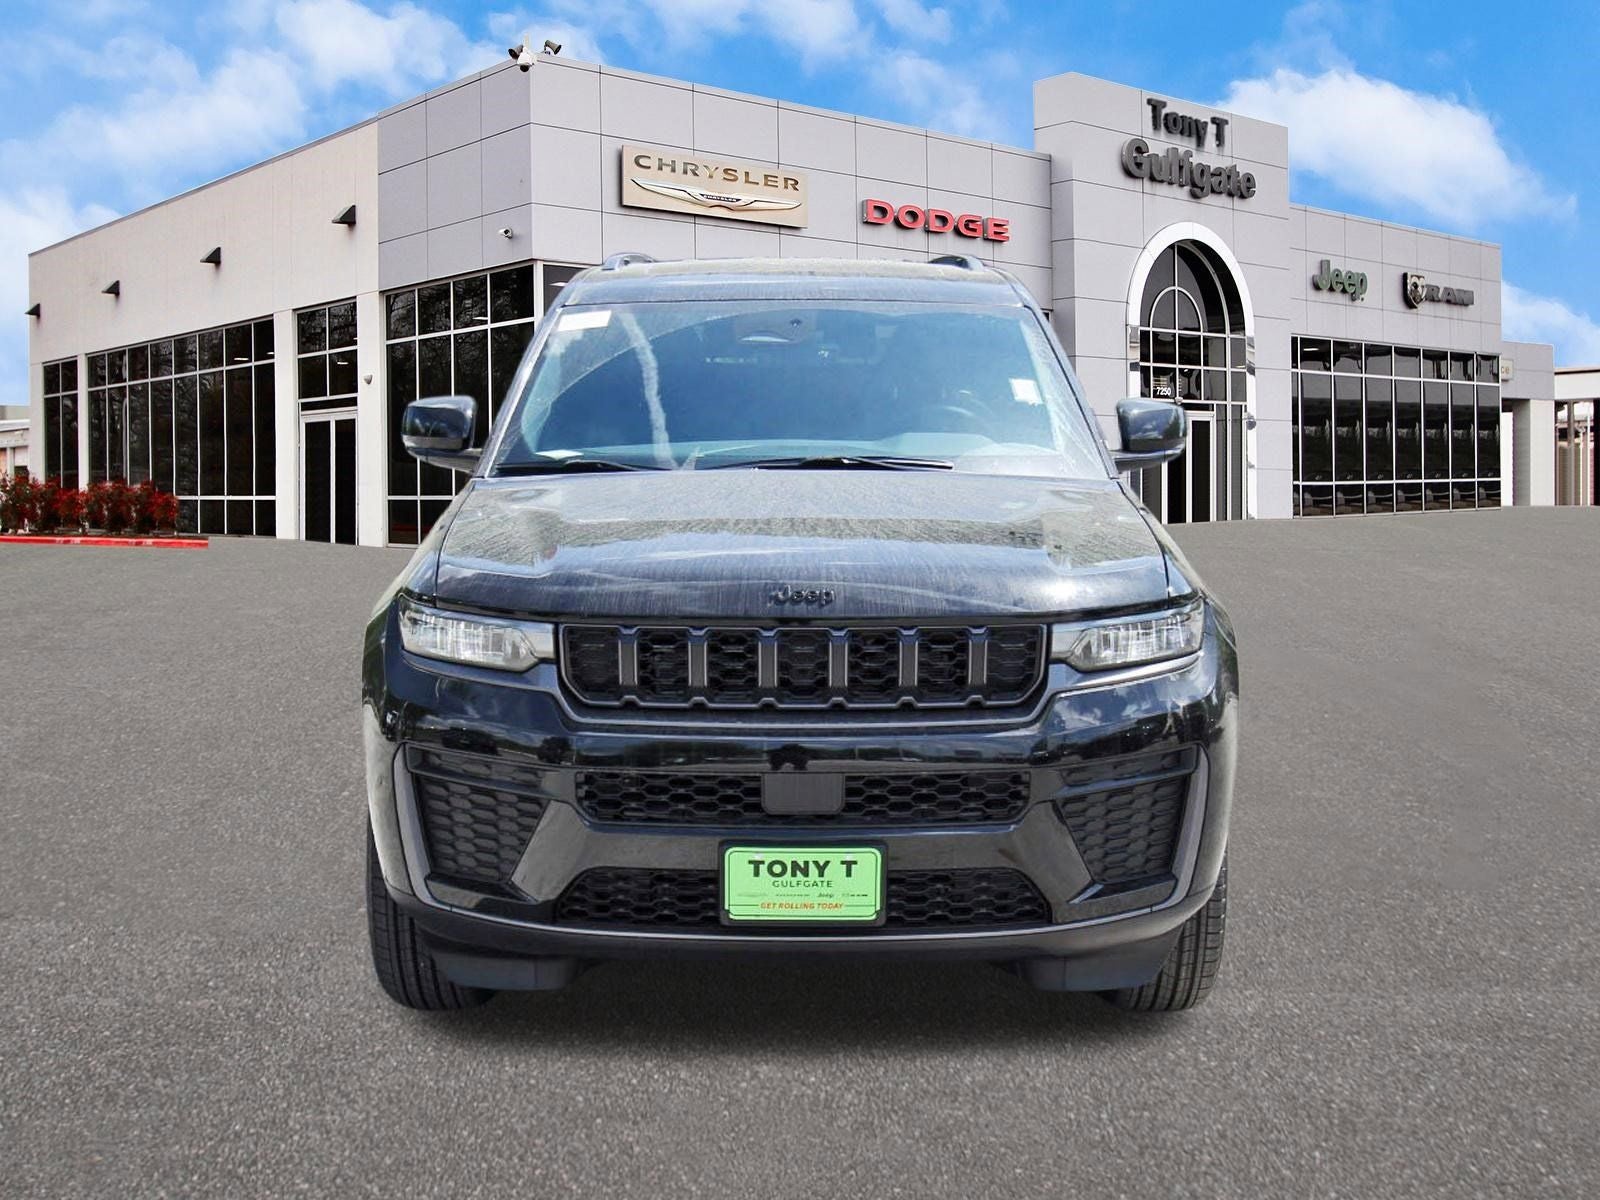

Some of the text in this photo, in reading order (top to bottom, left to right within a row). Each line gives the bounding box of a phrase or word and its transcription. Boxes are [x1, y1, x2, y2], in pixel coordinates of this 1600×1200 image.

[1147, 98, 1229, 148] Tony T
[634, 154, 800, 192] CHRYSLER
[1121, 138, 1257, 199] Gulfgate
[863, 199, 1011, 243] DODGE
[1313, 259, 1368, 301] Jeep
[1424, 284, 1475, 306] RAM
[1156, 386, 1172, 396] 7250
[769, 584, 836, 608] Jeep
[748, 859, 858, 878] TONY T
[772, 880, 833, 888] GULFGATE
